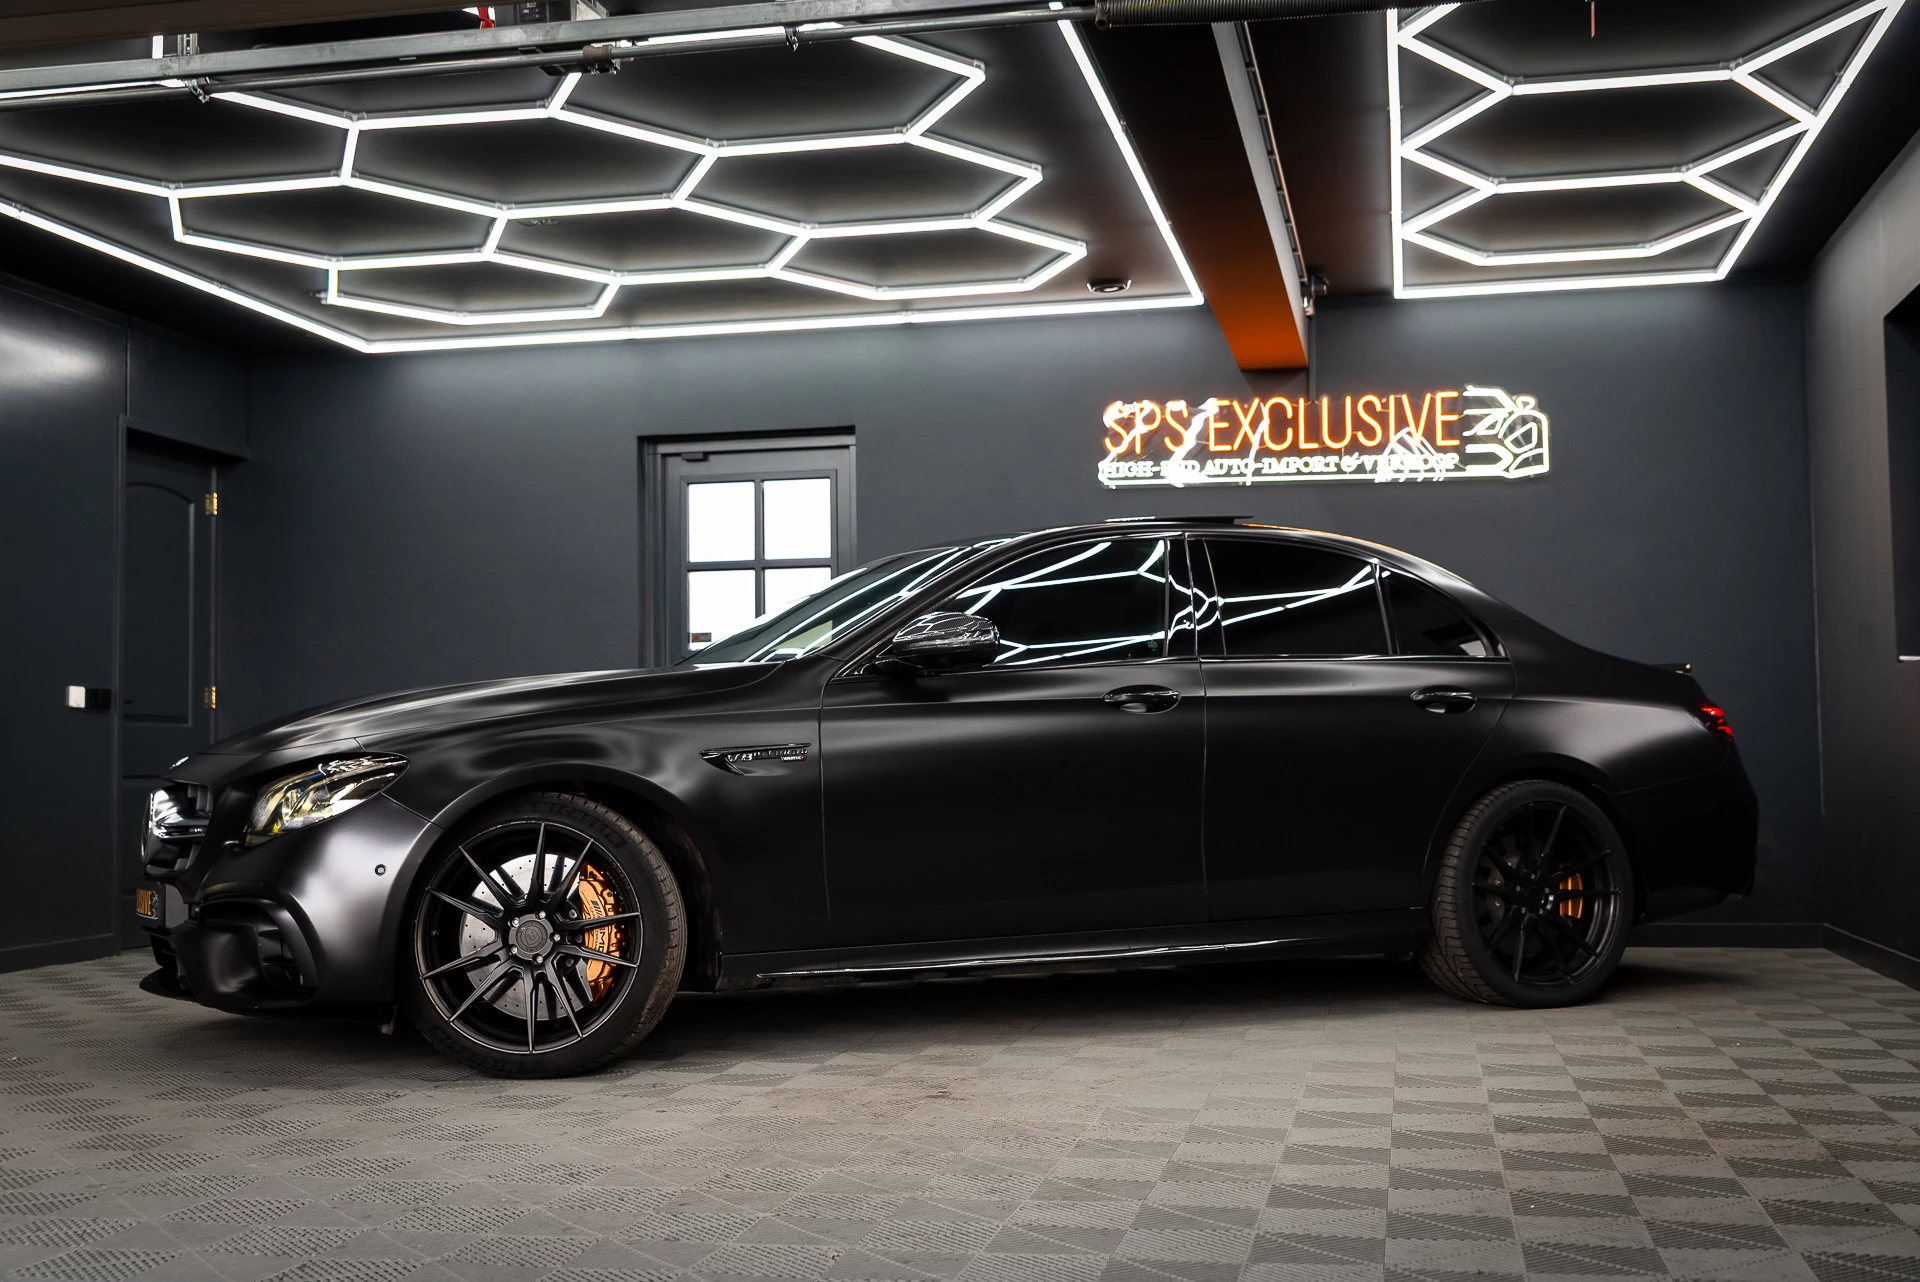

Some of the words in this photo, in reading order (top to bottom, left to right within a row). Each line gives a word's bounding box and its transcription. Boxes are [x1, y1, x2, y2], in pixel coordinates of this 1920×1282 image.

[1103, 400, 1188, 454] SPS
[1208, 390, 1460, 451] EXCLUSIVE
[1203, 456, 1339, 475] AUTO-IMPORT
[1341, 452, 1362, 472] &
[535, 801, 627, 849] MICHELIN
